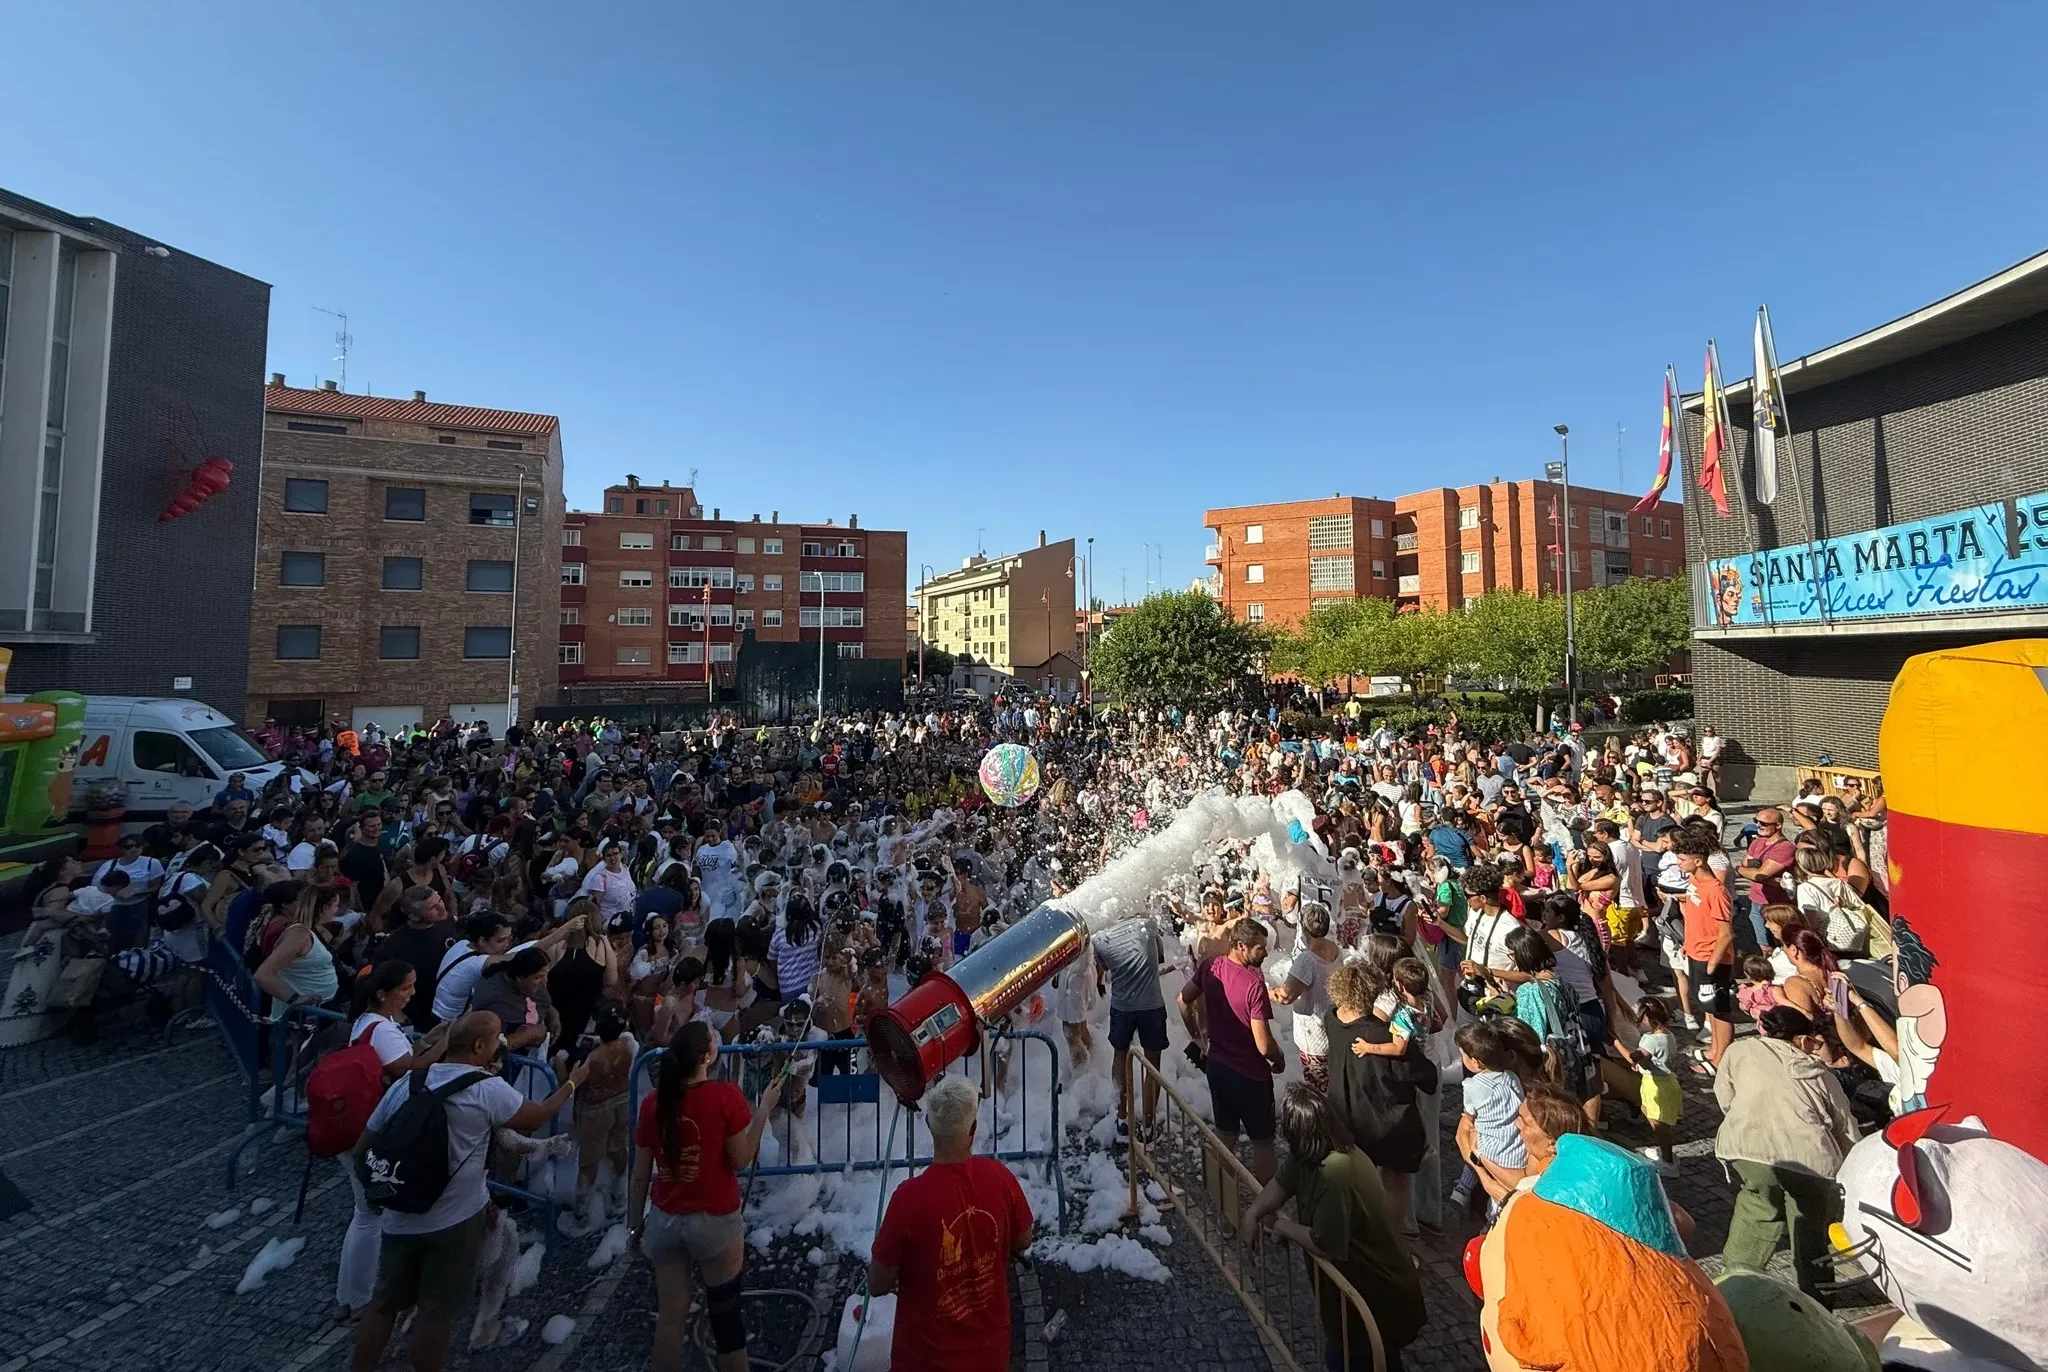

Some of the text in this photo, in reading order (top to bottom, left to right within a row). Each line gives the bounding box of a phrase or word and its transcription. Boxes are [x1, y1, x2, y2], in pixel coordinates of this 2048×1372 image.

[1749, 546, 1844, 588] SANTA
[1853, 518, 1984, 575] MARTA
[1907, 553, 2048, 607] Fiestas
